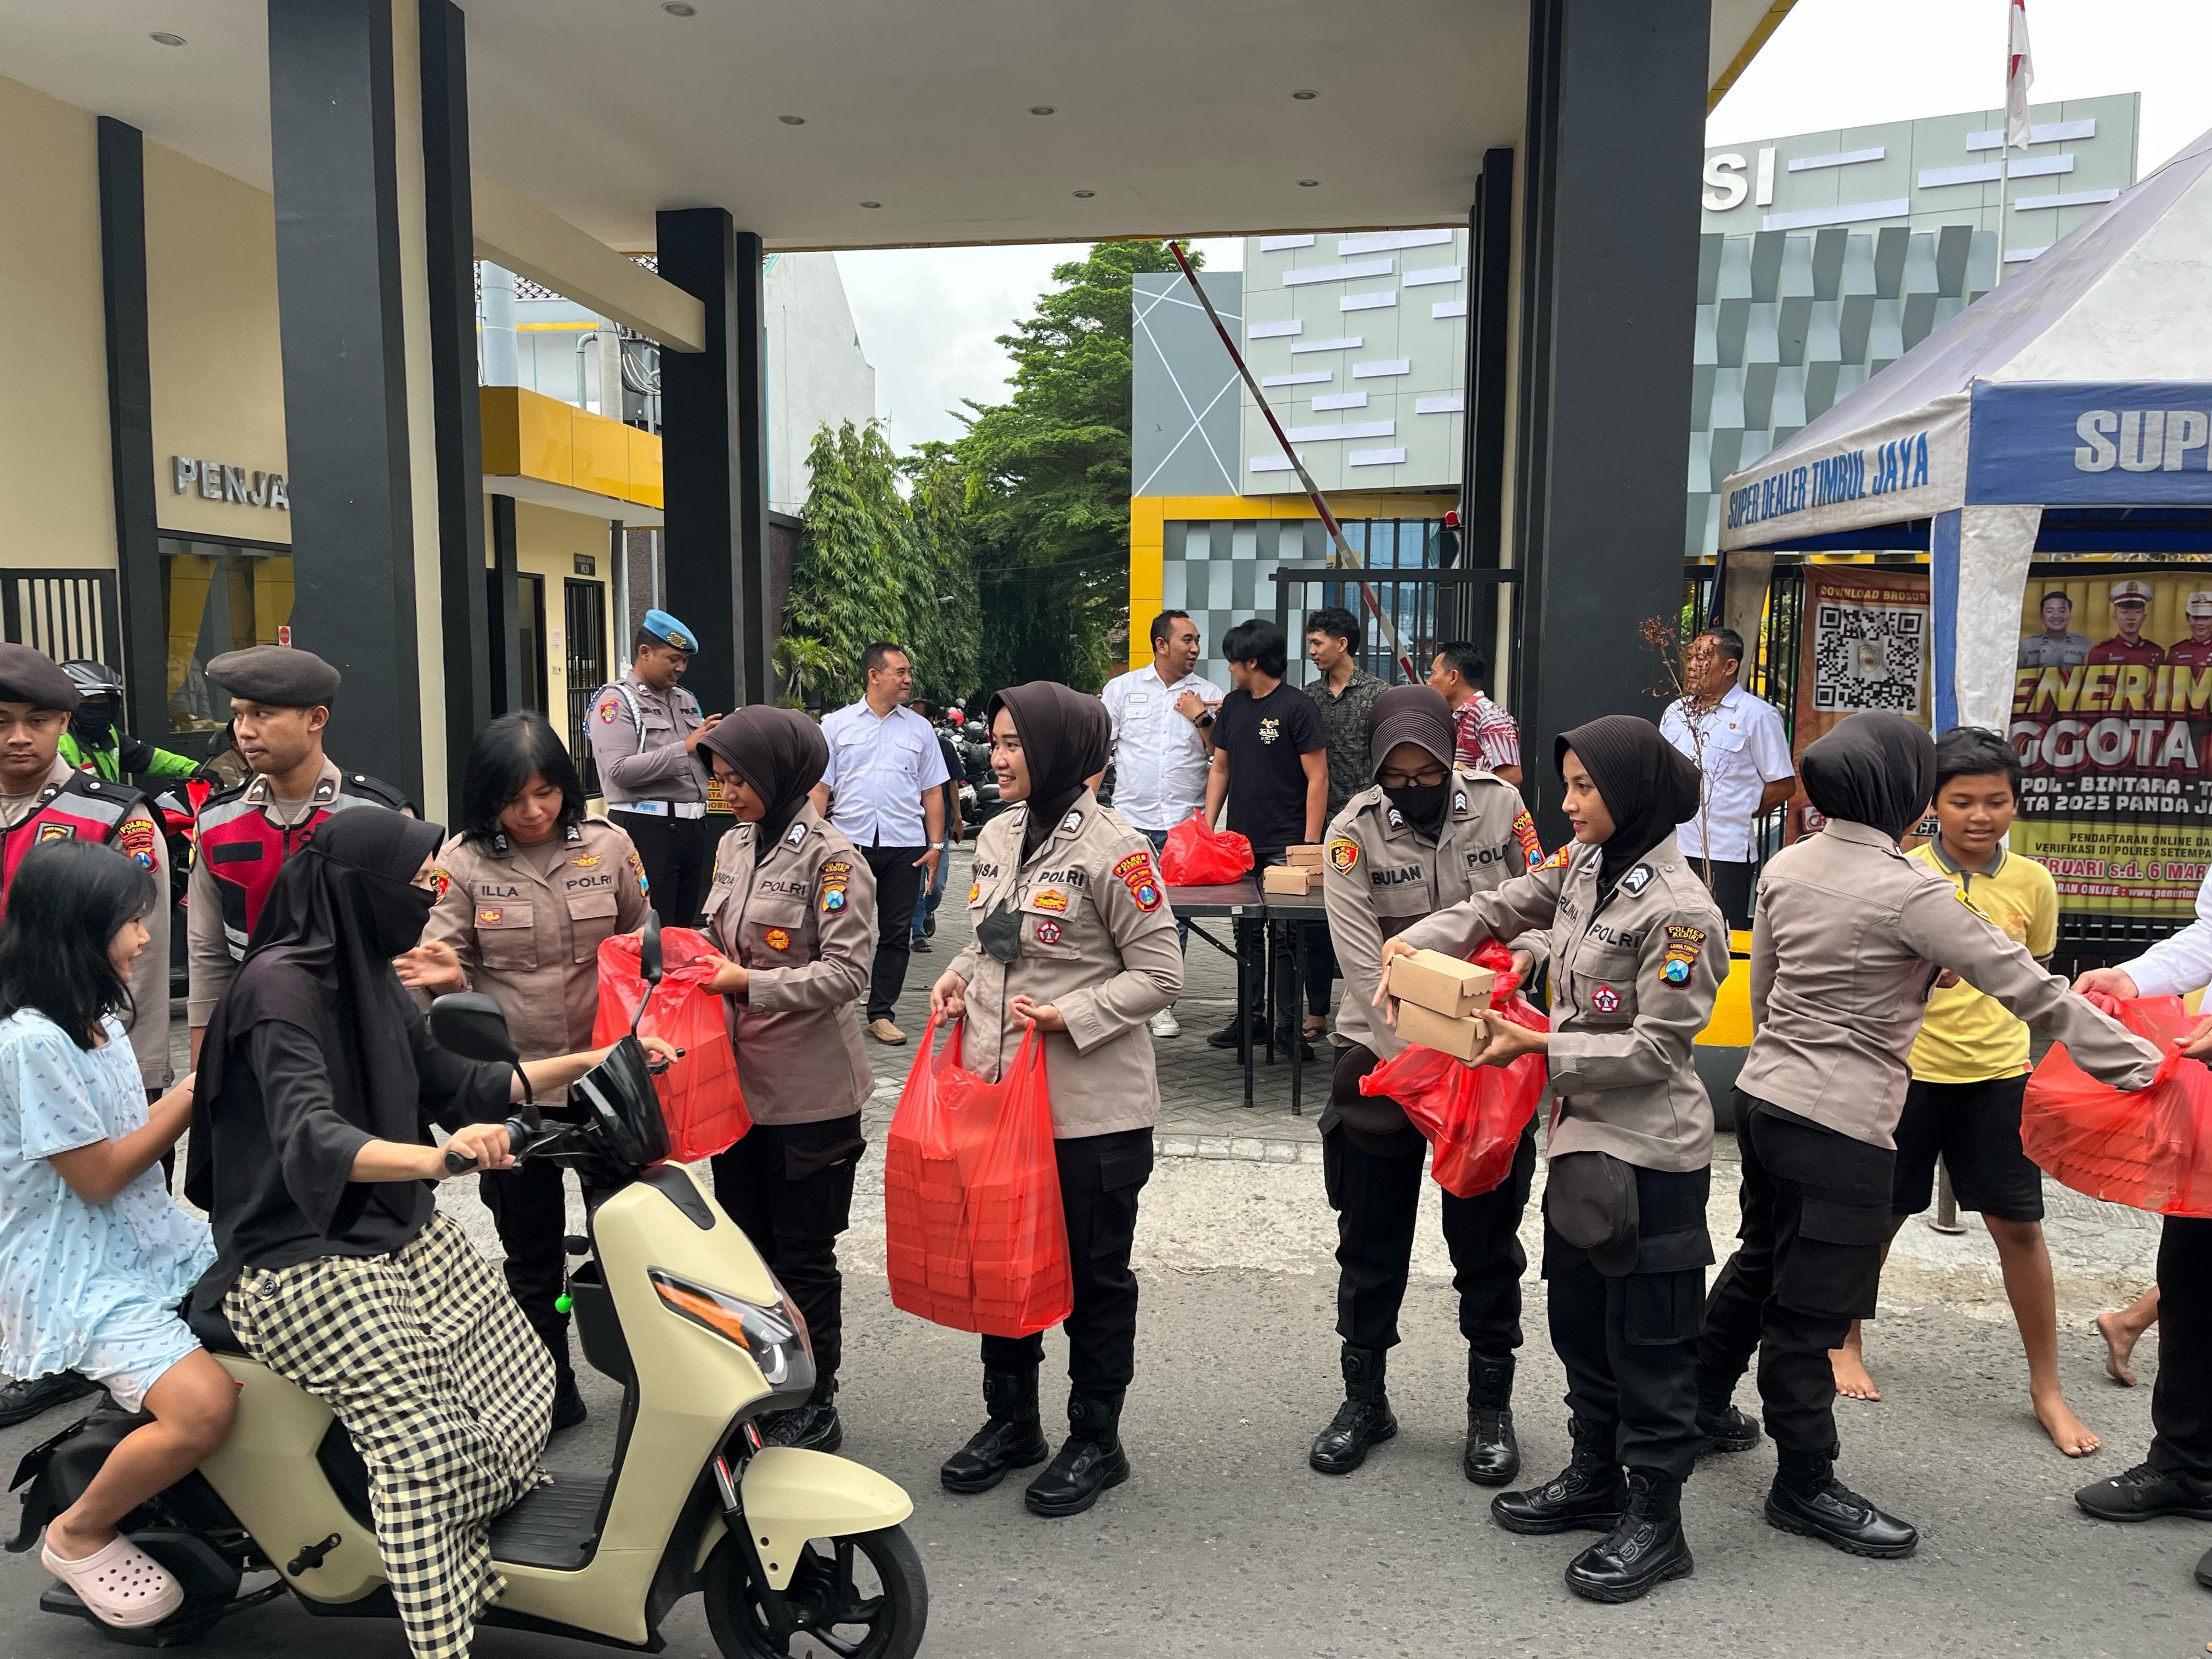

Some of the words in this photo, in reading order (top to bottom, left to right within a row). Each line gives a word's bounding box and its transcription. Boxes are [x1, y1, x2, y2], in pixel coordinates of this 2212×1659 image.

[1702, 146, 1776, 211] SI
[2074, 410, 2212, 472] SUP
[172, 455, 290, 510] PENJA
[1728, 483, 1760, 529] SUPER
[1762, 466, 1808, 521] DEALER
[1812, 449, 1866, 507] TIMBUL
[1872, 430, 1928, 496] JAYA
[1820, 585, 1880, 599] DOWNLOAD
[1883, 590, 1927, 601] BROSUR
[2011, 664, 2212, 713] ENERIM
[2021, 777, 2062, 794] POL
[2080, 776, 2181, 794] BINTARA
[2198, 780, 2212, 796] T
[2024, 795, 2050, 811] TA
[2055, 795, 2110, 811] 2025
[2116, 795, 2189, 813] PANDA
[120, 821, 152, 834] POLRES
[2070, 833, 2148, 845] PENDAFTARAN
[2152, 836, 2192, 846] ONLINE
[2196, 837, 2212, 847] DA
[2035, 843, 2095, 854] VERIFIKASI
[2100, 845, 2111, 855] DI
[2114, 845, 2156, 856] POLRES
[2160, 847, 2212, 858] SETEMPA
[1115, 854, 1147, 873] POLRES
[2109, 862, 2142, 879] s.d.
[2149, 863, 2160, 878] 6
[566, 875, 612, 890] POLRI
[1038, 870, 1084, 887] POLRI
[1371, 865, 1421, 885] BULAN
[482, 885, 518, 897] ILLA
[760, 880, 806, 896] POLRI
[2081, 884, 2119, 896] ONLINE
[1589, 923, 1640, 948] POLRI
[1668, 926, 1705, 939] POLRES
[1672, 932, 1699, 943] KEDIRI
